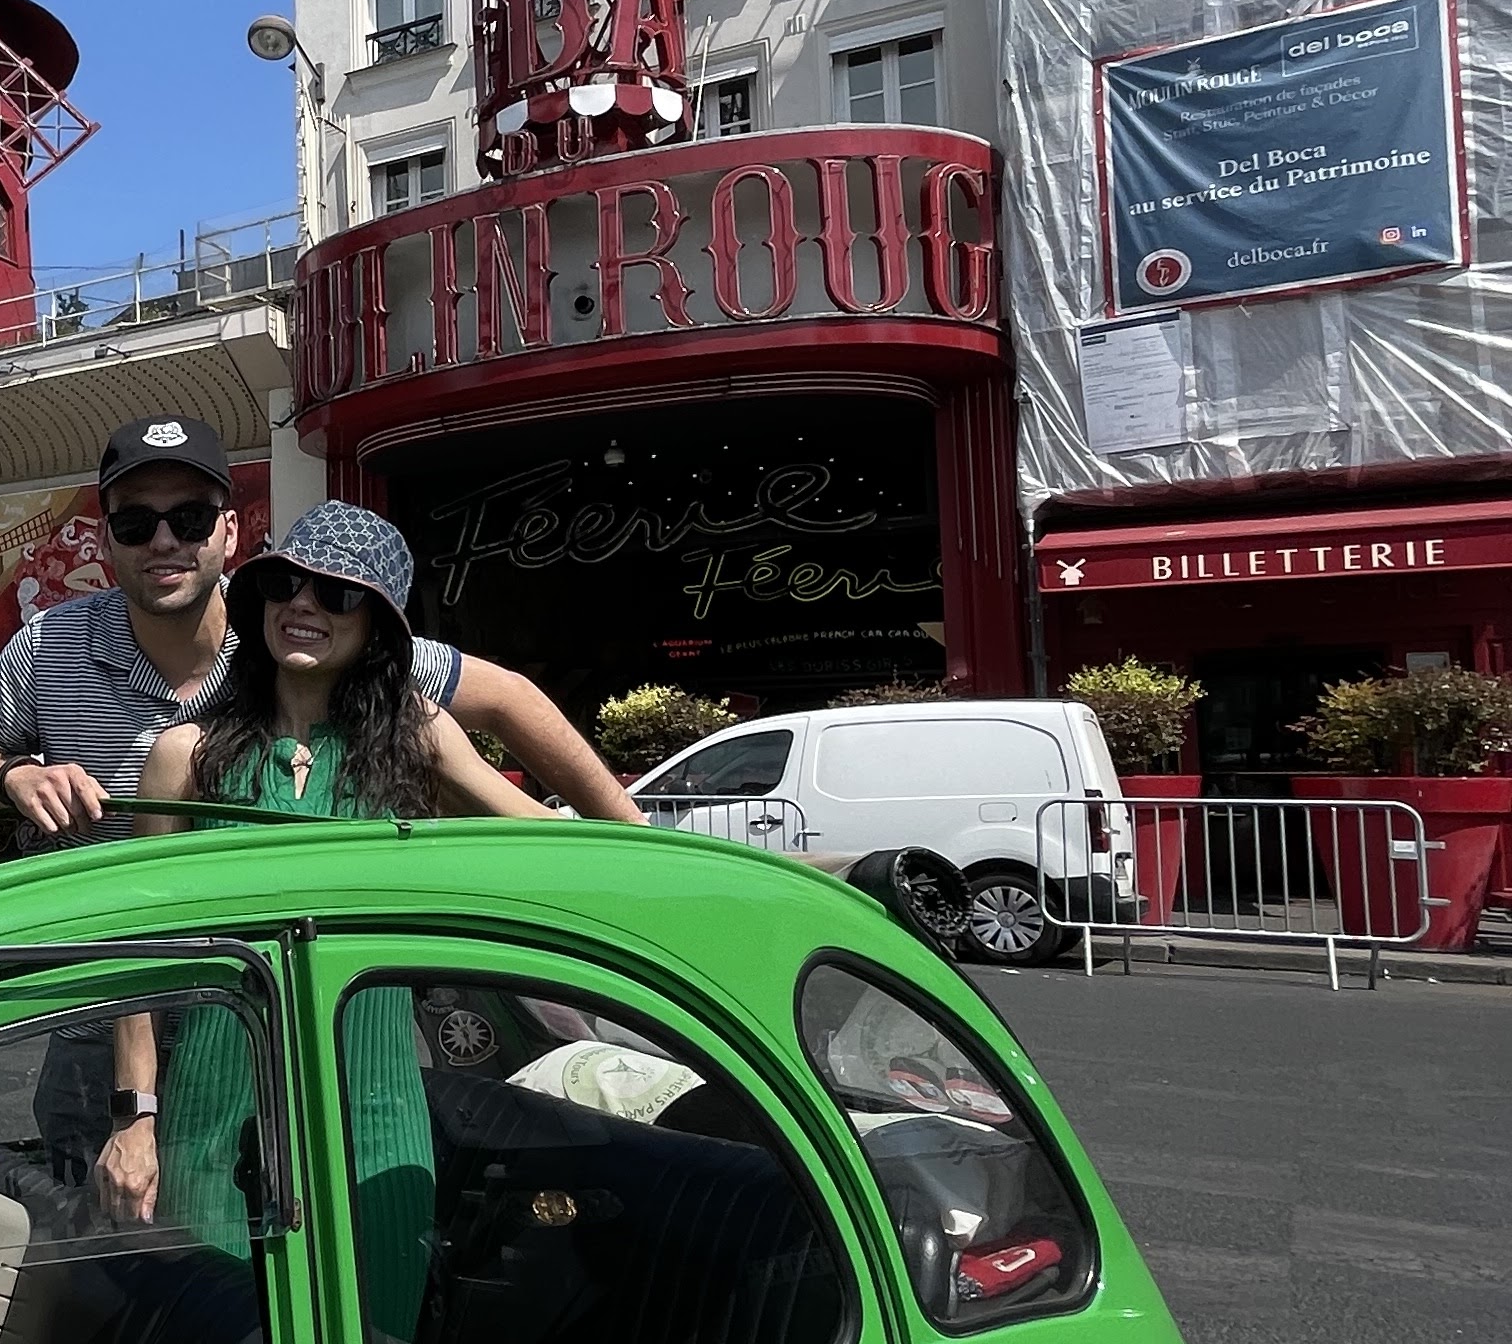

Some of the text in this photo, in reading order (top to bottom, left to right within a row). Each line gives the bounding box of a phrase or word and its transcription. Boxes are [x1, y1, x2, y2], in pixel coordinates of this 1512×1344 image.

[1288, 38, 1330, 58] del
[1336, 19, 1410, 48] boca
[1196, 64, 1262, 91] ROUGE
[1218, 144, 1327, 179] Del Boca
[1129, 149, 1431, 217] au service du Patrimoine
[1226, 238, 1329, 269] delboca.fr
[1152, 539, 1445, 581] BILLETTERIE
